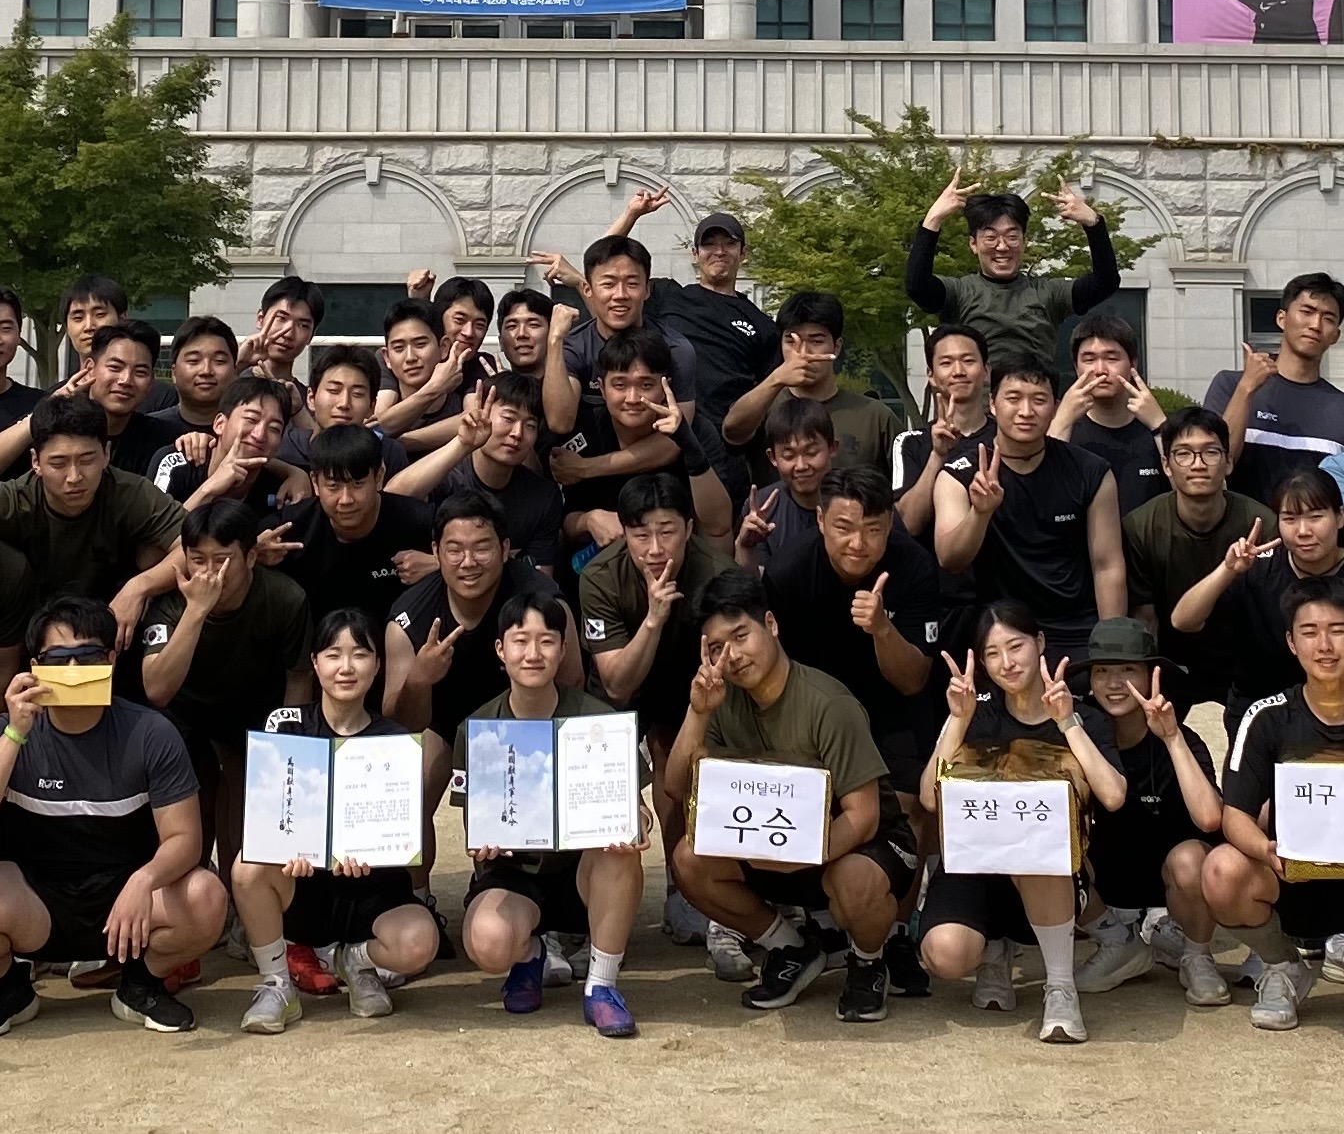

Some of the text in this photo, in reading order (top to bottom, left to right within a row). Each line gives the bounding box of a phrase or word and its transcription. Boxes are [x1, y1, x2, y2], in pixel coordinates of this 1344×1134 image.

[38, 778, 64, 790] ROTC
[730, 780, 795, 798] 이어달리기
[1294, 782, 1337, 806] 피구
[960, 799, 1053, 822] 풋살 우승
[724, 806, 797, 847] 우승
